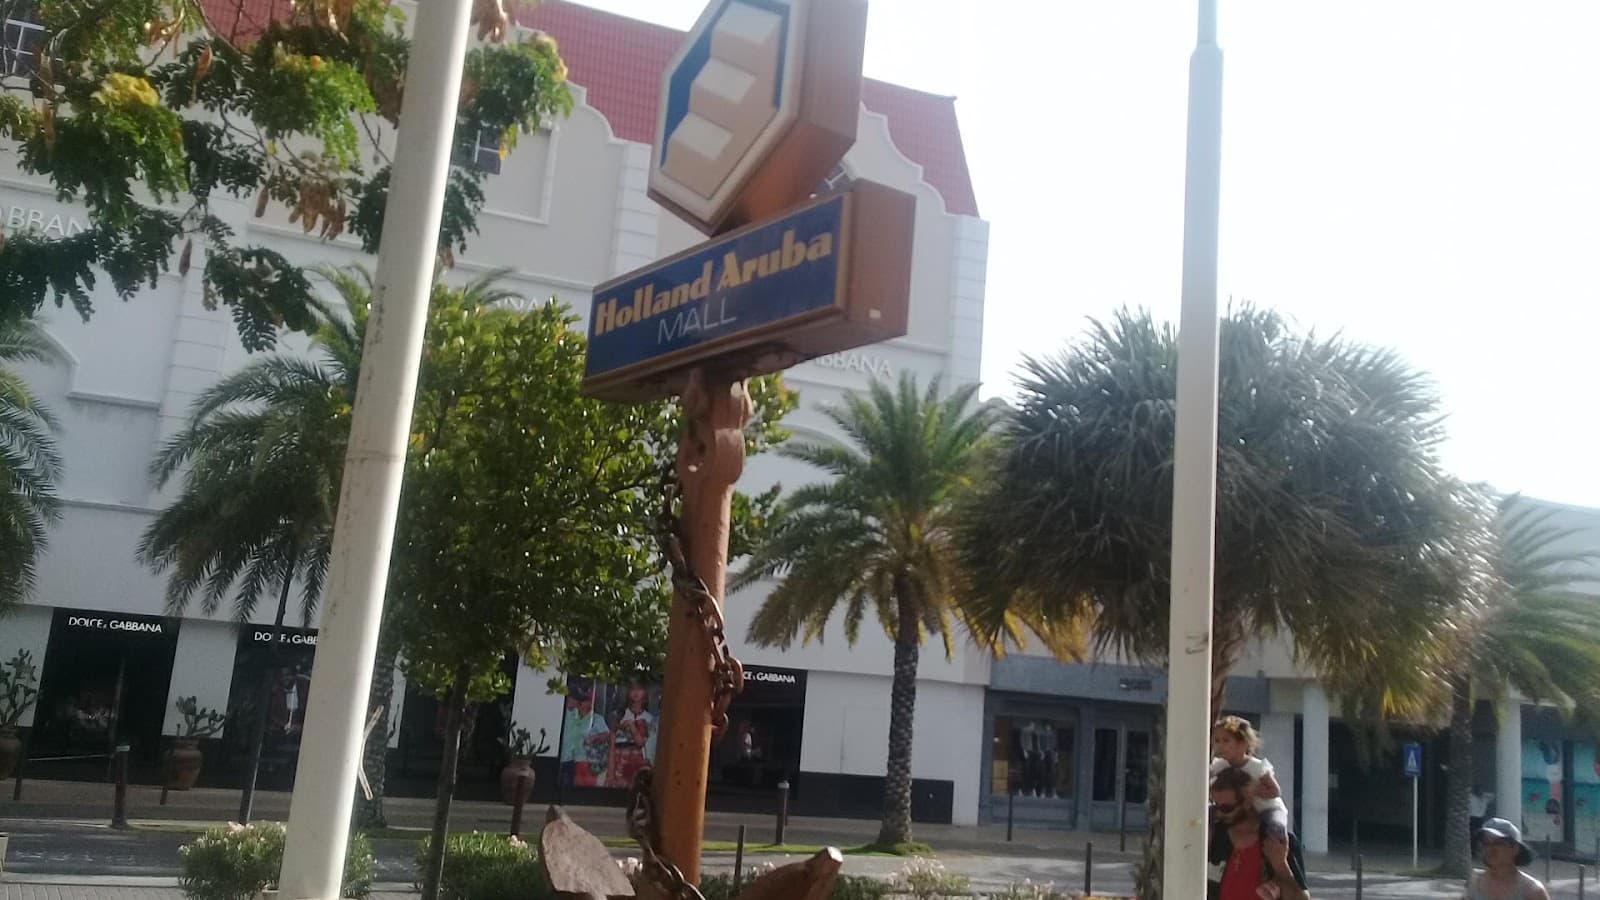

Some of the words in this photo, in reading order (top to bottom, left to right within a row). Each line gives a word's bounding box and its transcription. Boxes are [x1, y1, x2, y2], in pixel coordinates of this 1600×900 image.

[594, 260, 714, 337] Holland
[717, 229, 833, 291] Aruba
[657, 297, 737, 345] MALL
[68, 616, 103, 629] DOLCE
[109, 620, 162, 633] GABBANA
[756, 672, 796, 684] GABBANA
